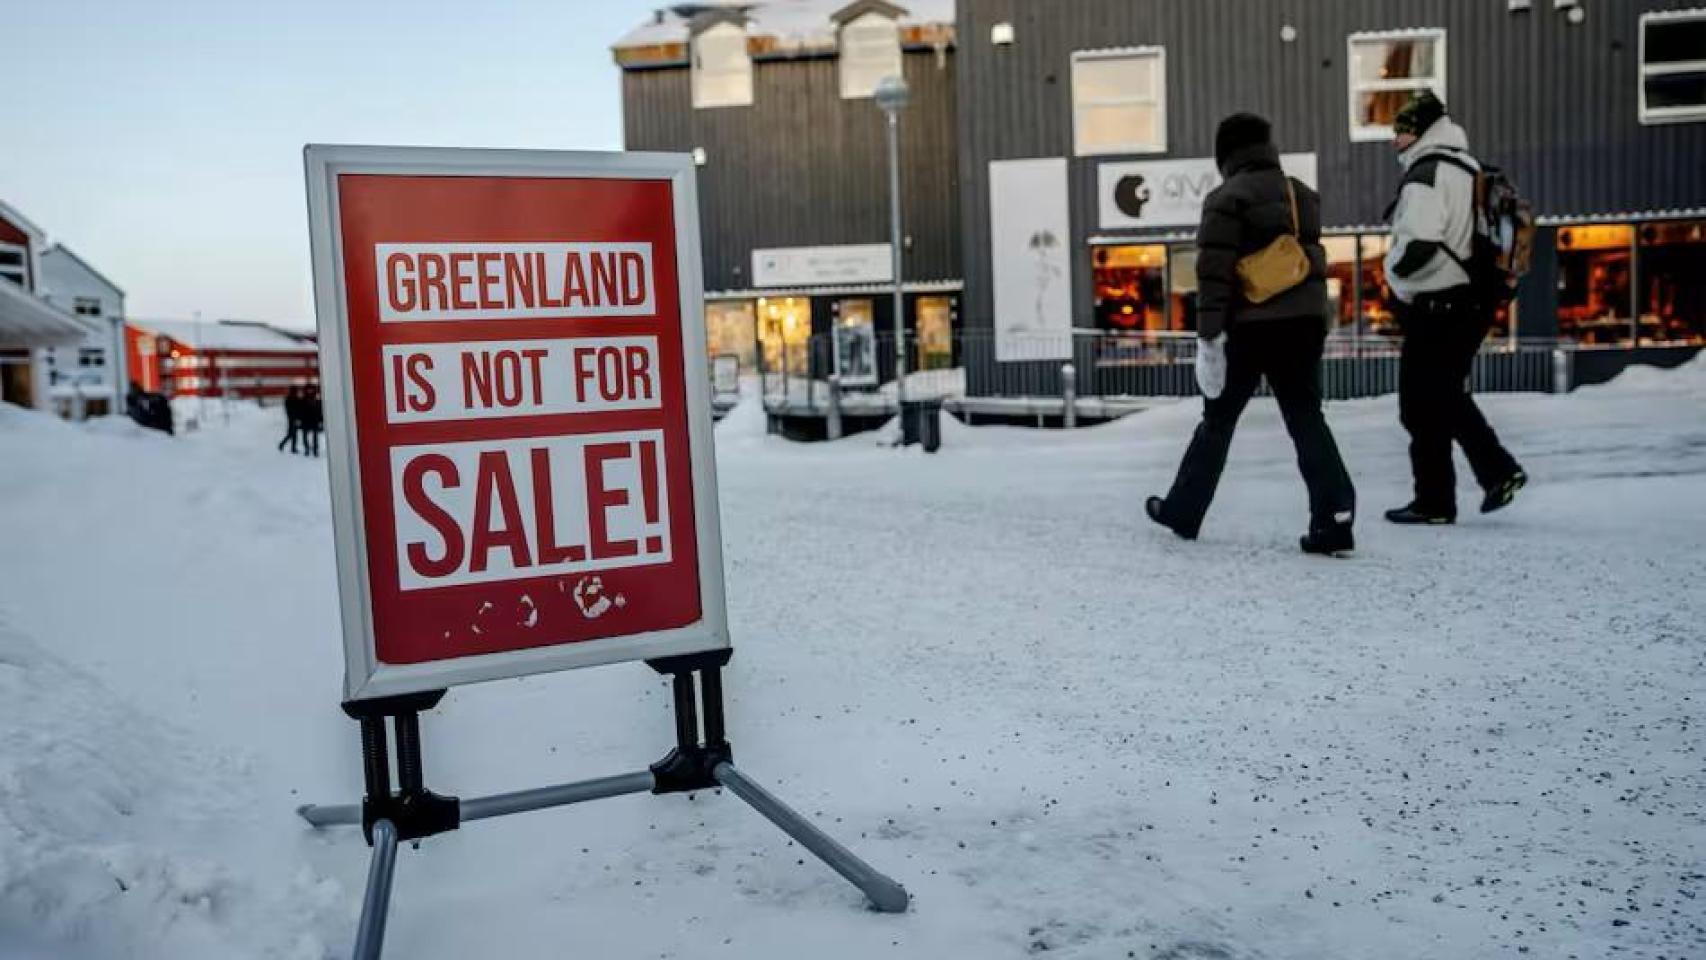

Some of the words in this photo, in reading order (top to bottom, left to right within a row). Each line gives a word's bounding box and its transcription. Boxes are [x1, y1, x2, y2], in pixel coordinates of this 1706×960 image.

[386, 251, 646, 312] GREENLAND
[393, 353, 436, 413] IS
[461, 349, 548, 409] NOT
[574, 345, 652, 402] FOR
[403, 440, 663, 578] SALE!
